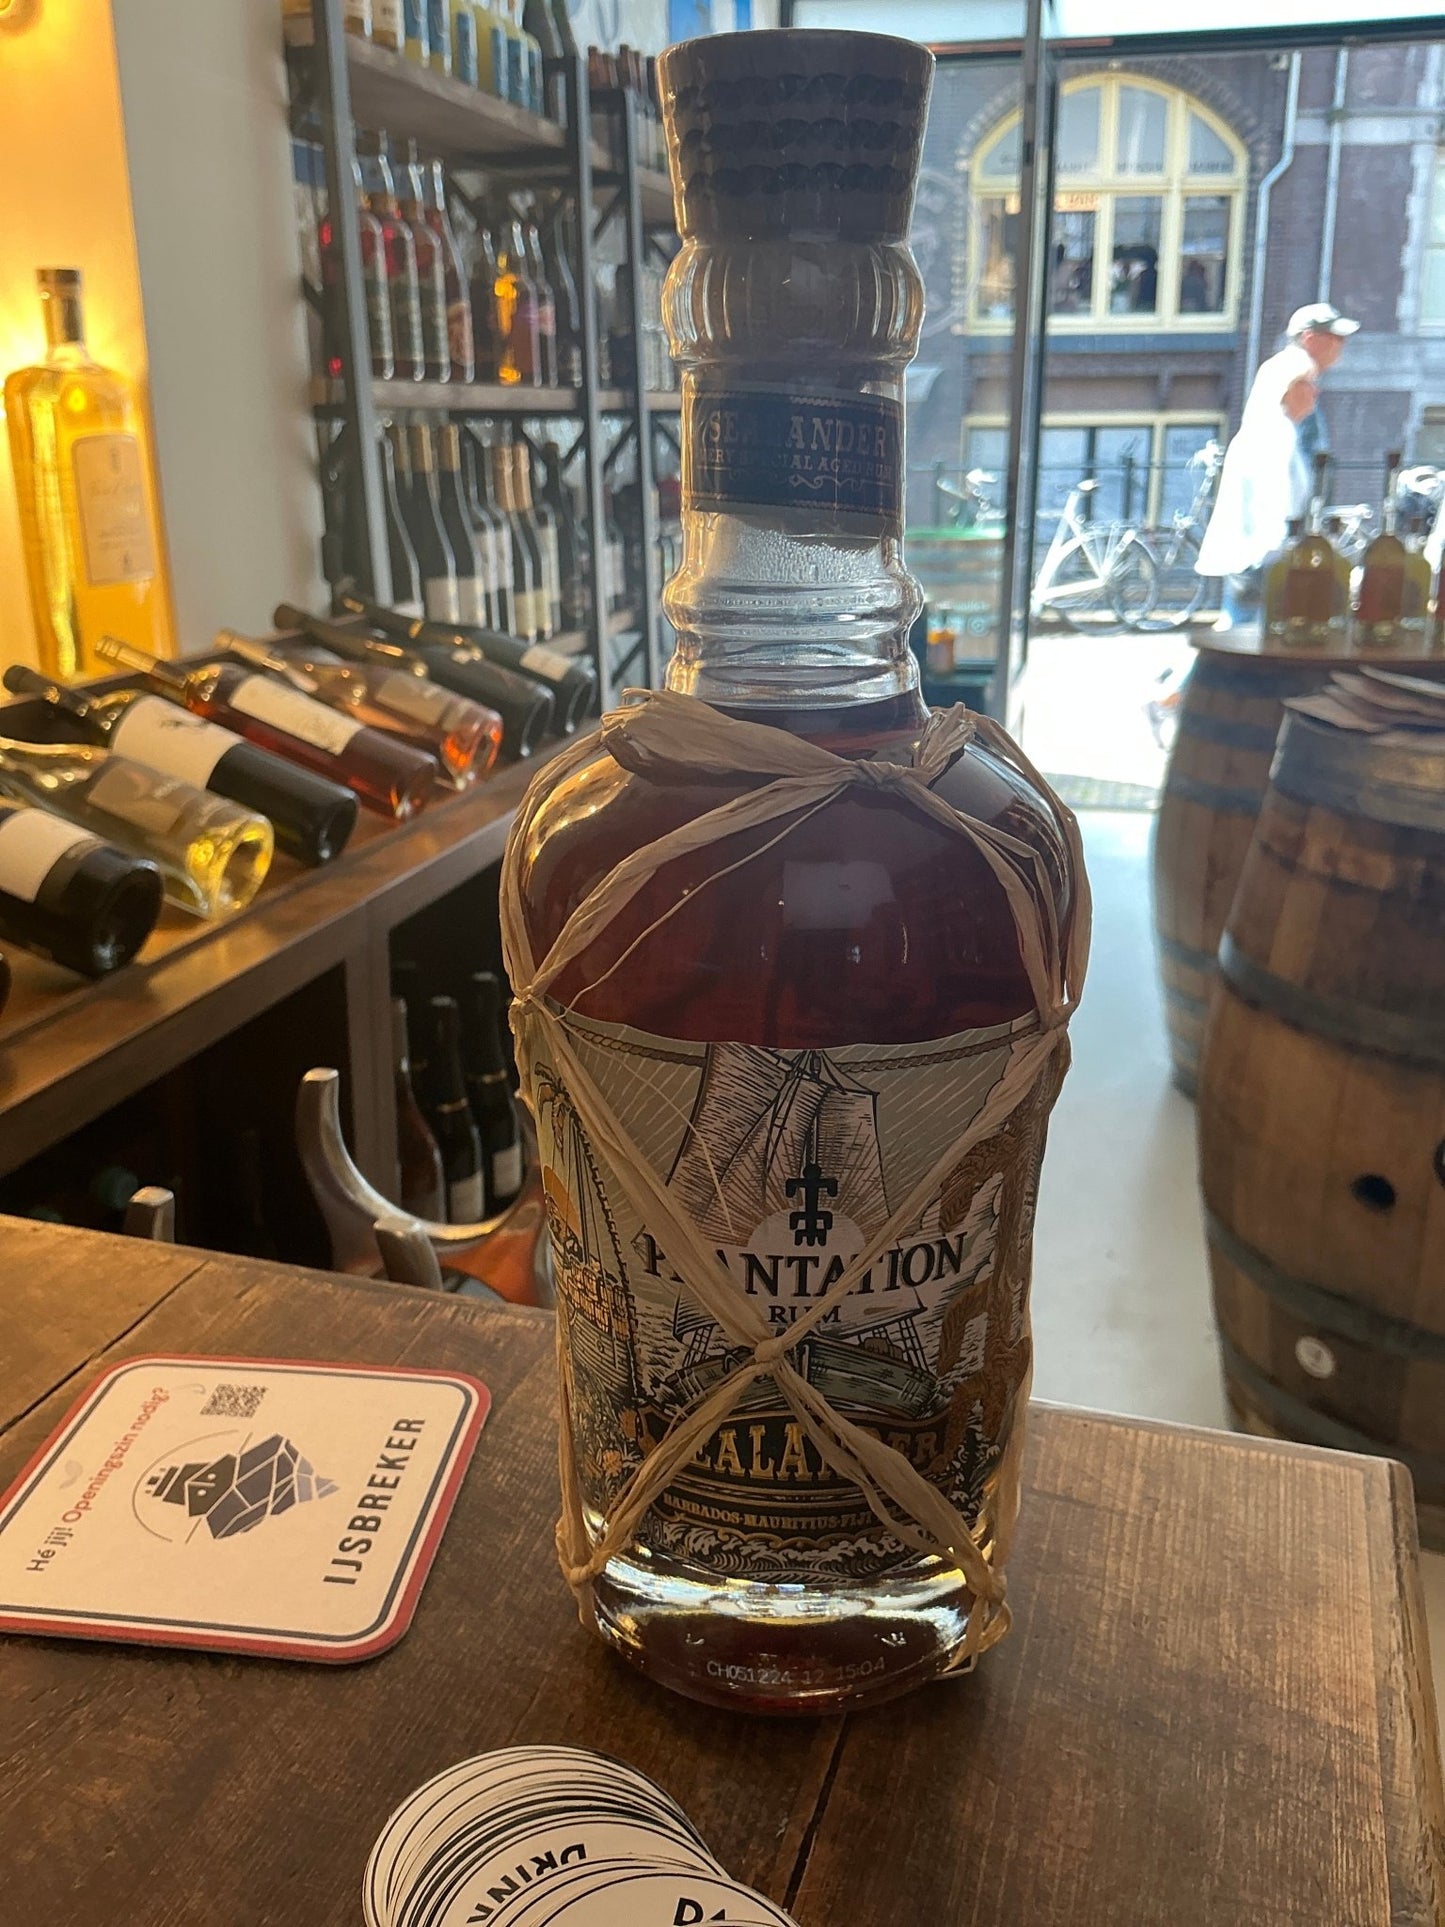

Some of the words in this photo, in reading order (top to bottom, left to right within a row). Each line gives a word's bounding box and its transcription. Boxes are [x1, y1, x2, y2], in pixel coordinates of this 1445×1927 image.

[643, 1230, 968, 1299] PNTATION
[768, 1304, 842, 1324] RUM
[26, 1548, 56, 1572] Hé
[44, 1526, 74, 1548] jij!
[61, 1432, 139, 1524] Openingszin
[130, 1386, 171, 1432] nodig?
[322, 1418, 426, 1585] IJSBREKER
